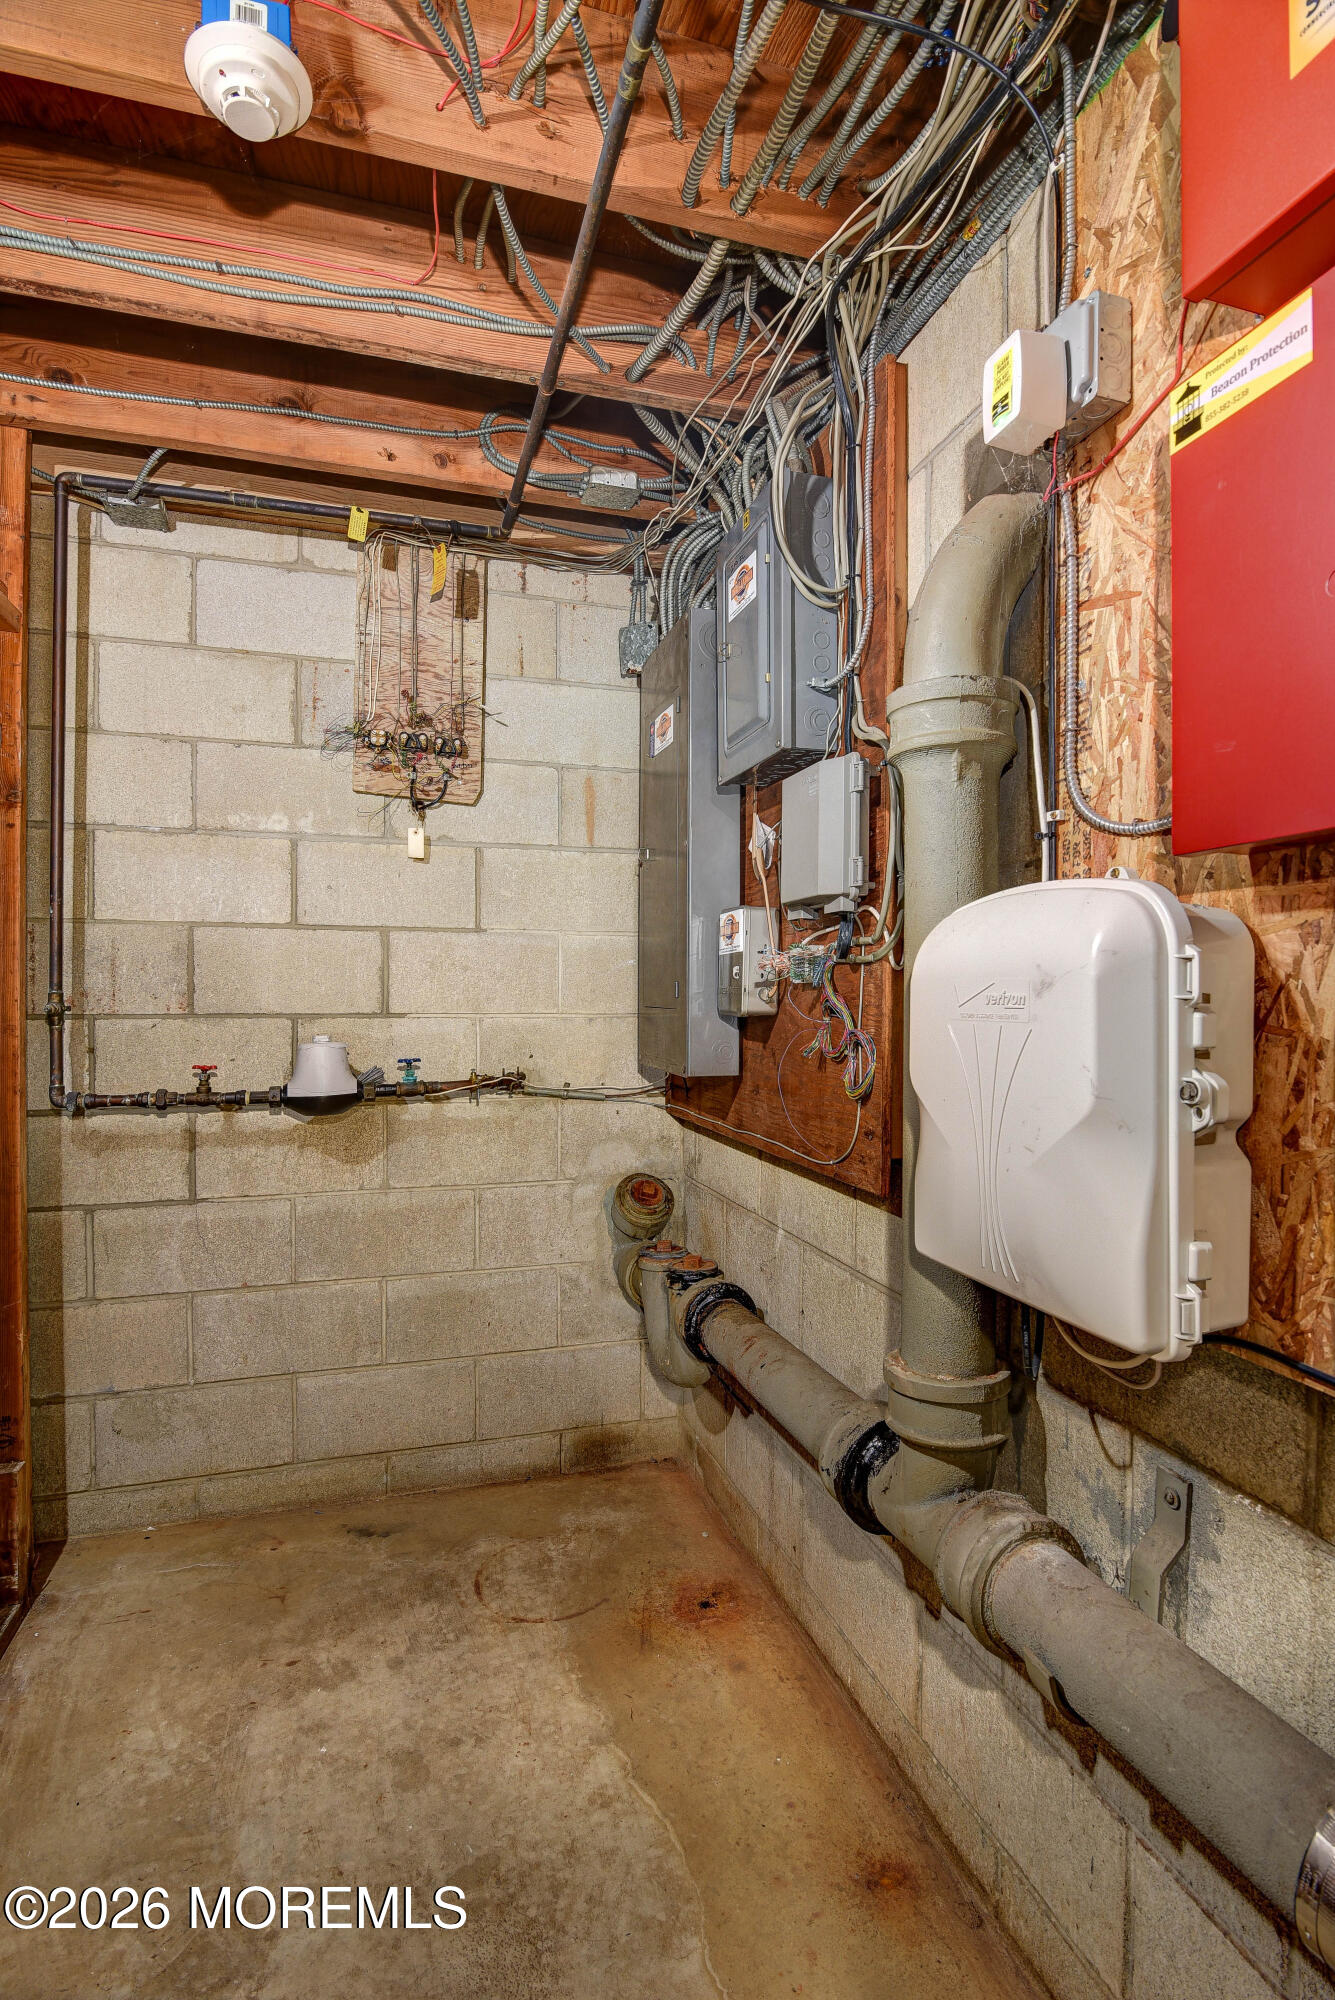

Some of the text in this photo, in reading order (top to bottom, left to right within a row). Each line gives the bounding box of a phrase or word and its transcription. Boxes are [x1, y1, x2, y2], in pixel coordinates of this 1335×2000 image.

[1205, 350, 1237, 380] Protected
[1210, 324, 1309, 399] Beacon Protection
